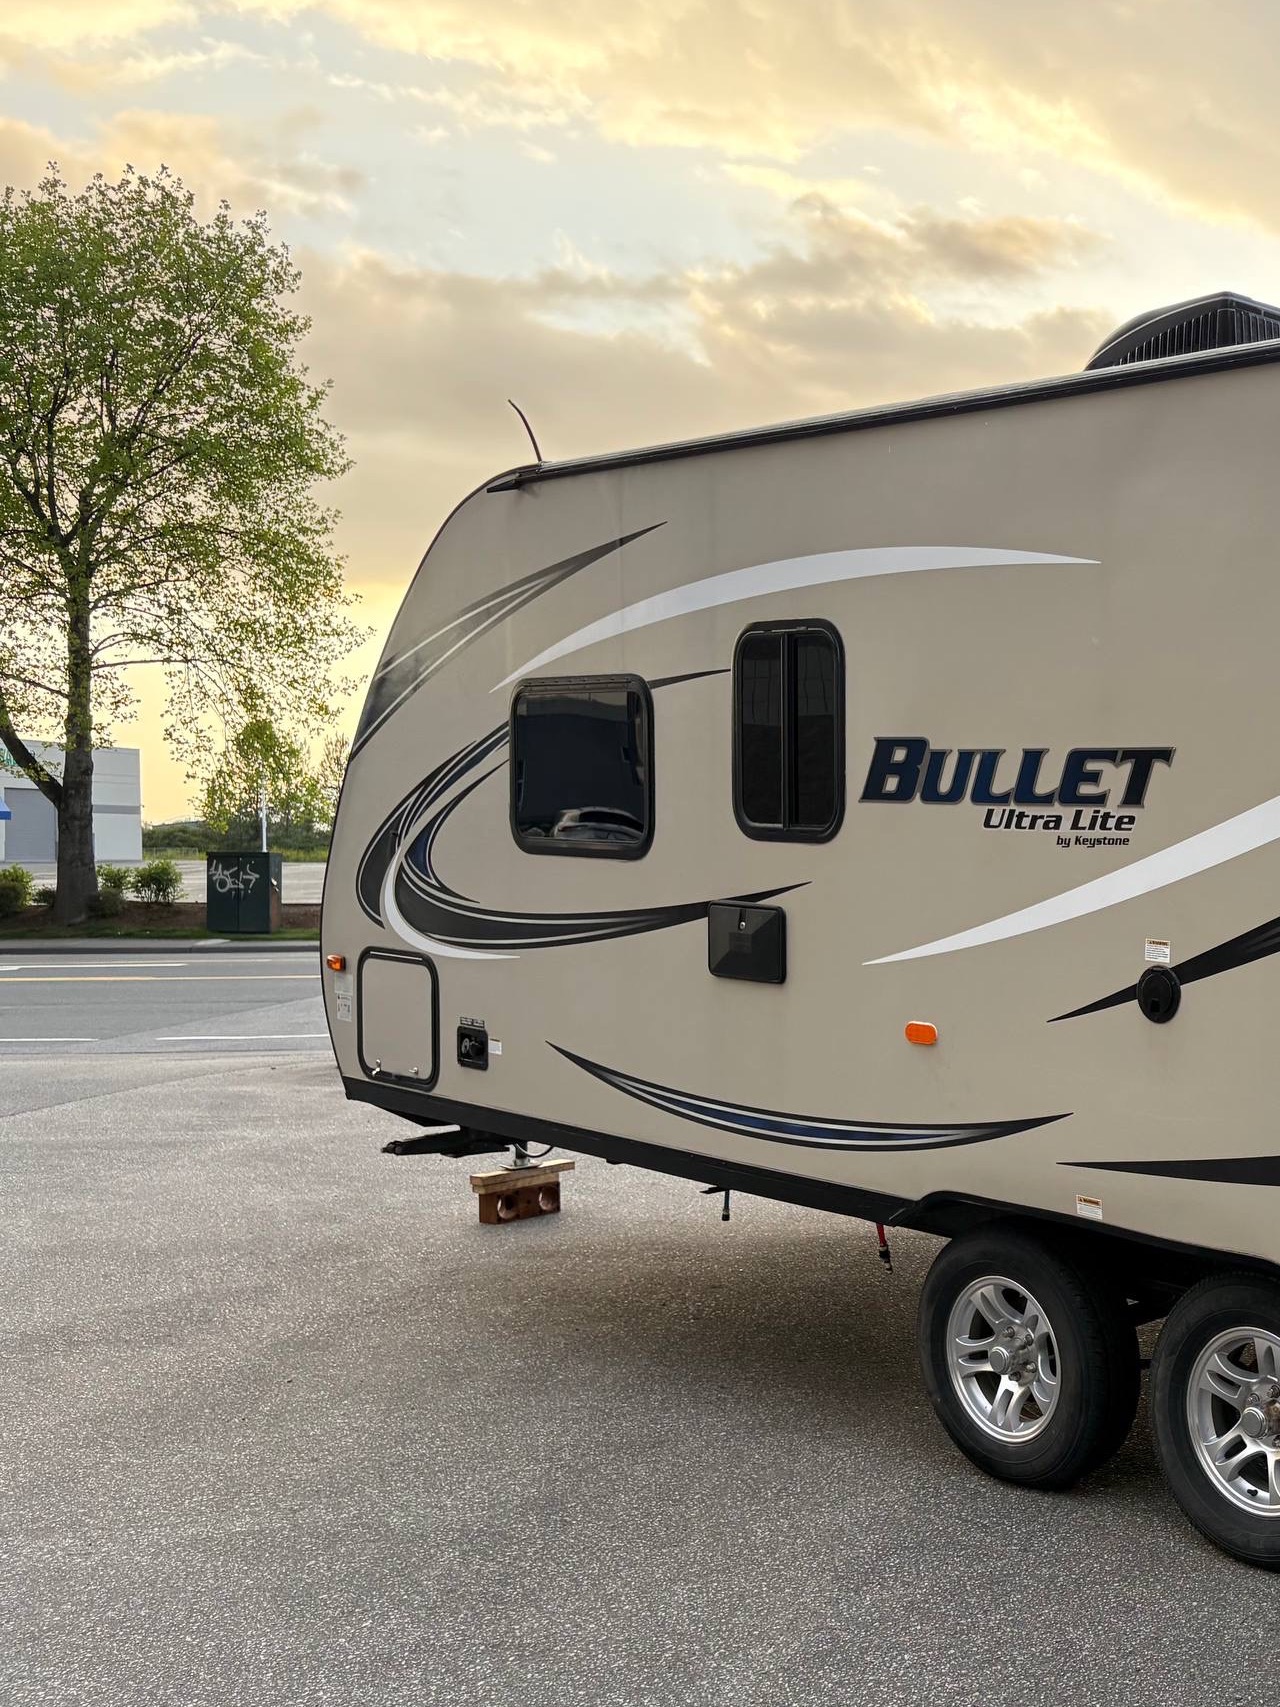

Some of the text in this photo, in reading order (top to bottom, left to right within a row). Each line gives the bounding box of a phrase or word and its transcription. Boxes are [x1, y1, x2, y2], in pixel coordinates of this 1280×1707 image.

[858, 736, 1176, 808] BULLET
[983, 808, 1136, 832] Ultra Lite
[1056, 835, 1129, 848] by Keystone
